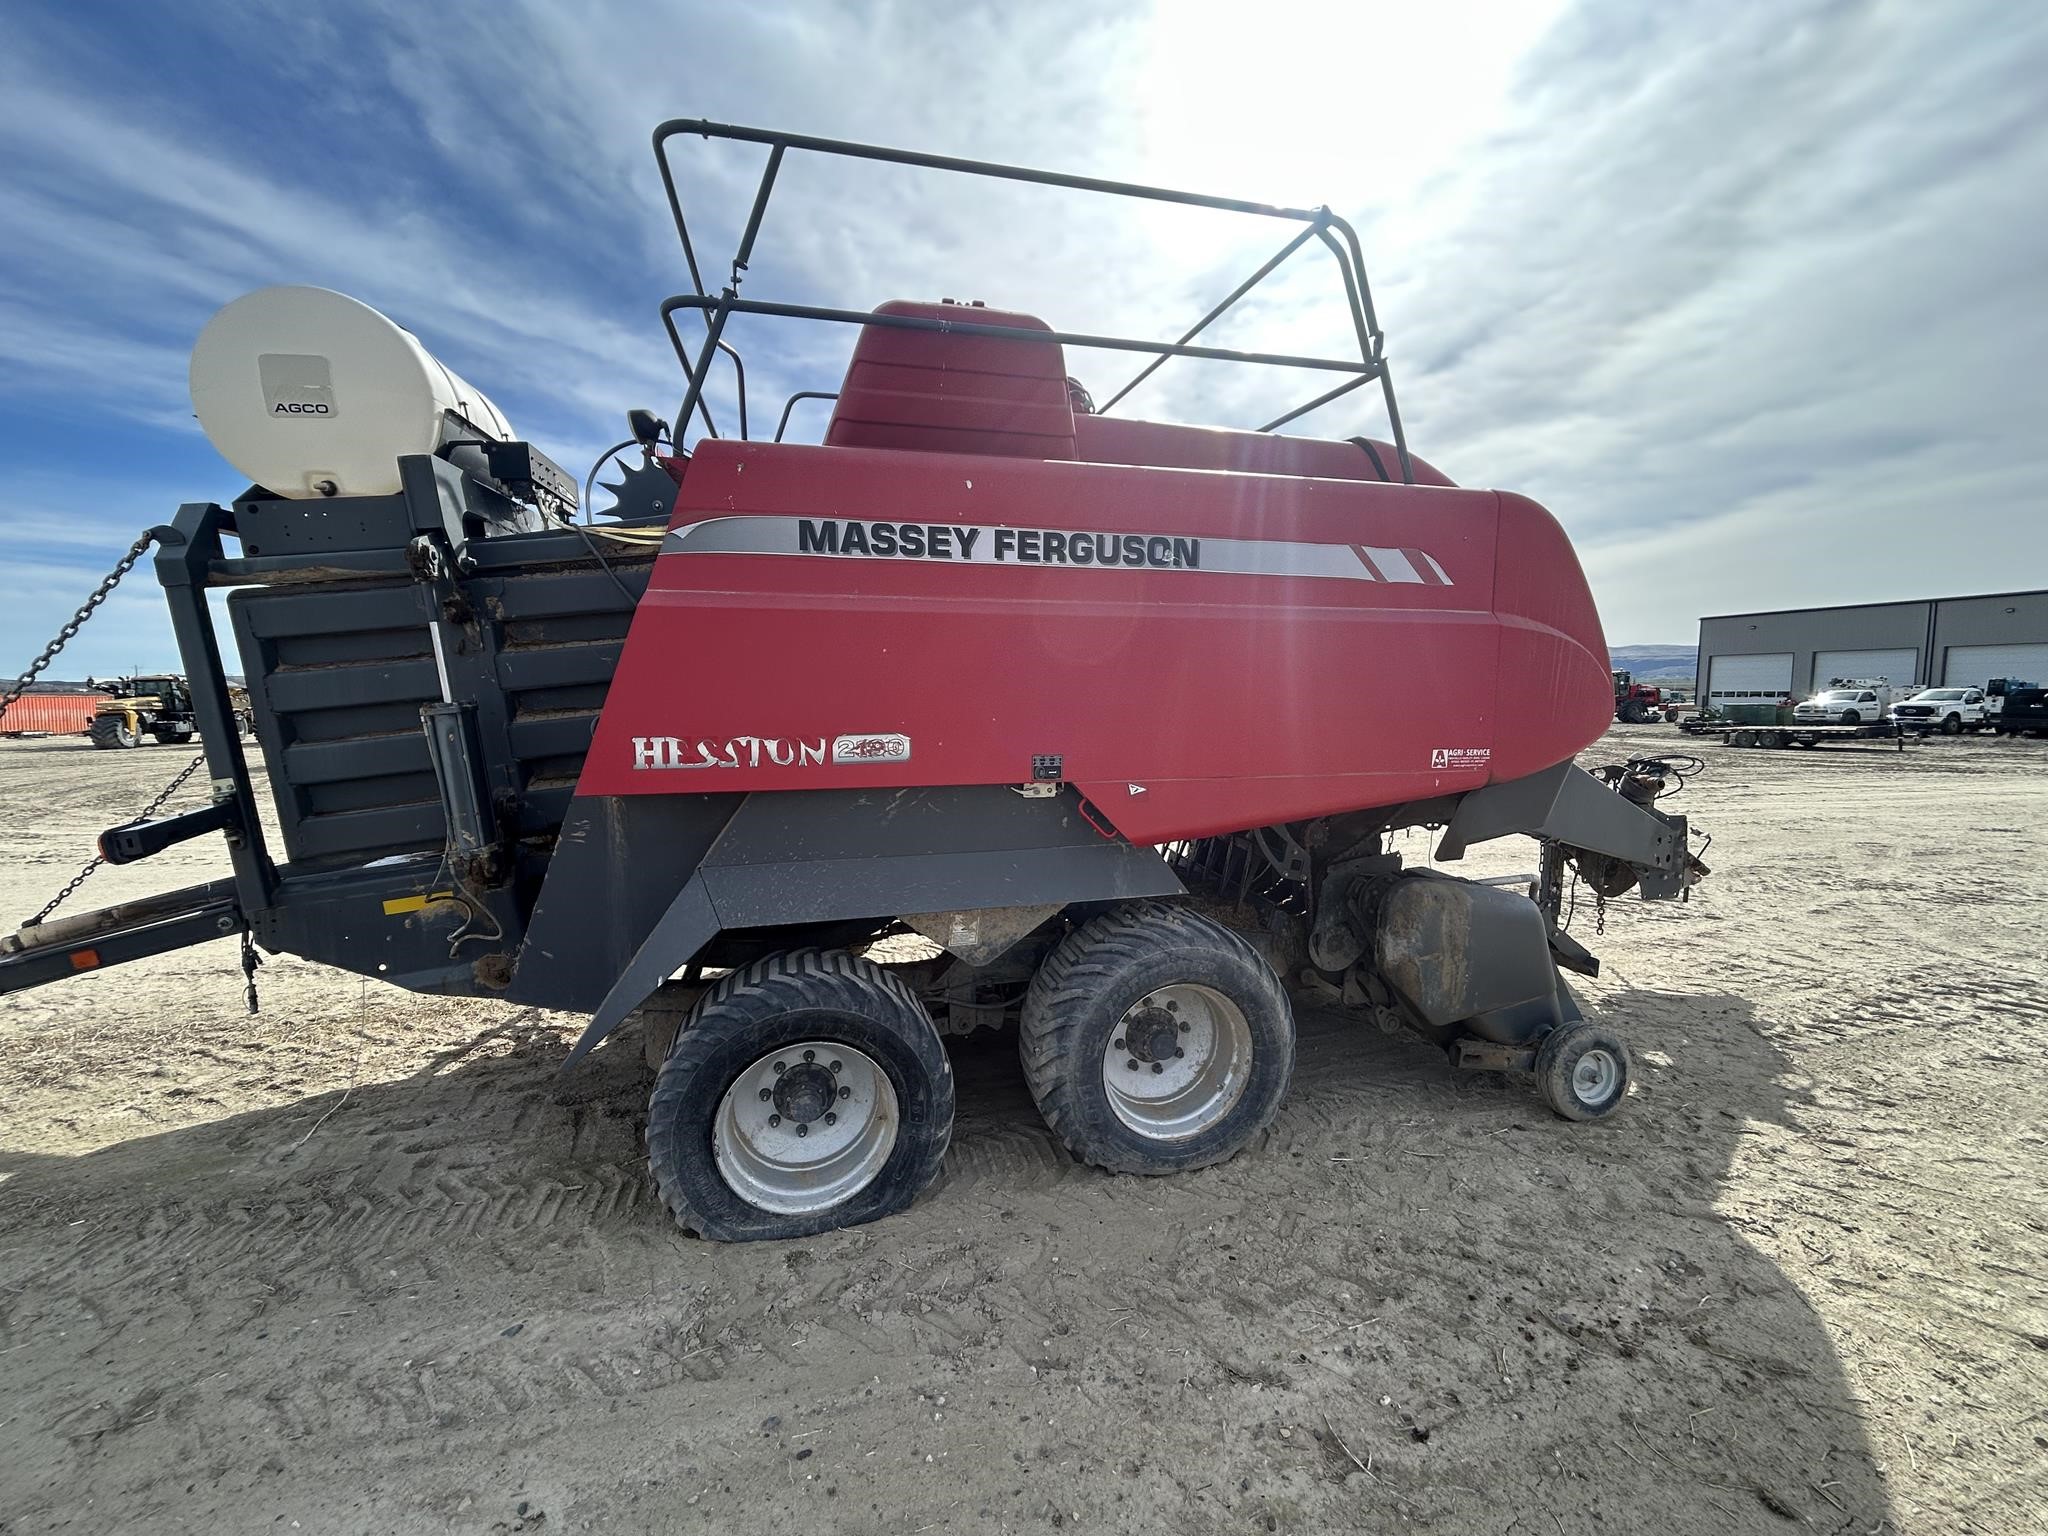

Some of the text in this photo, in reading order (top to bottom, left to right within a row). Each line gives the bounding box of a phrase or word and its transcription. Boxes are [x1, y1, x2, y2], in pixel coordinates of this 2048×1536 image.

[275, 403, 328, 414] AGCO
[798, 519, 1200, 568] MASSEY FERGUSON
[632, 735, 827, 769] HESSTON
